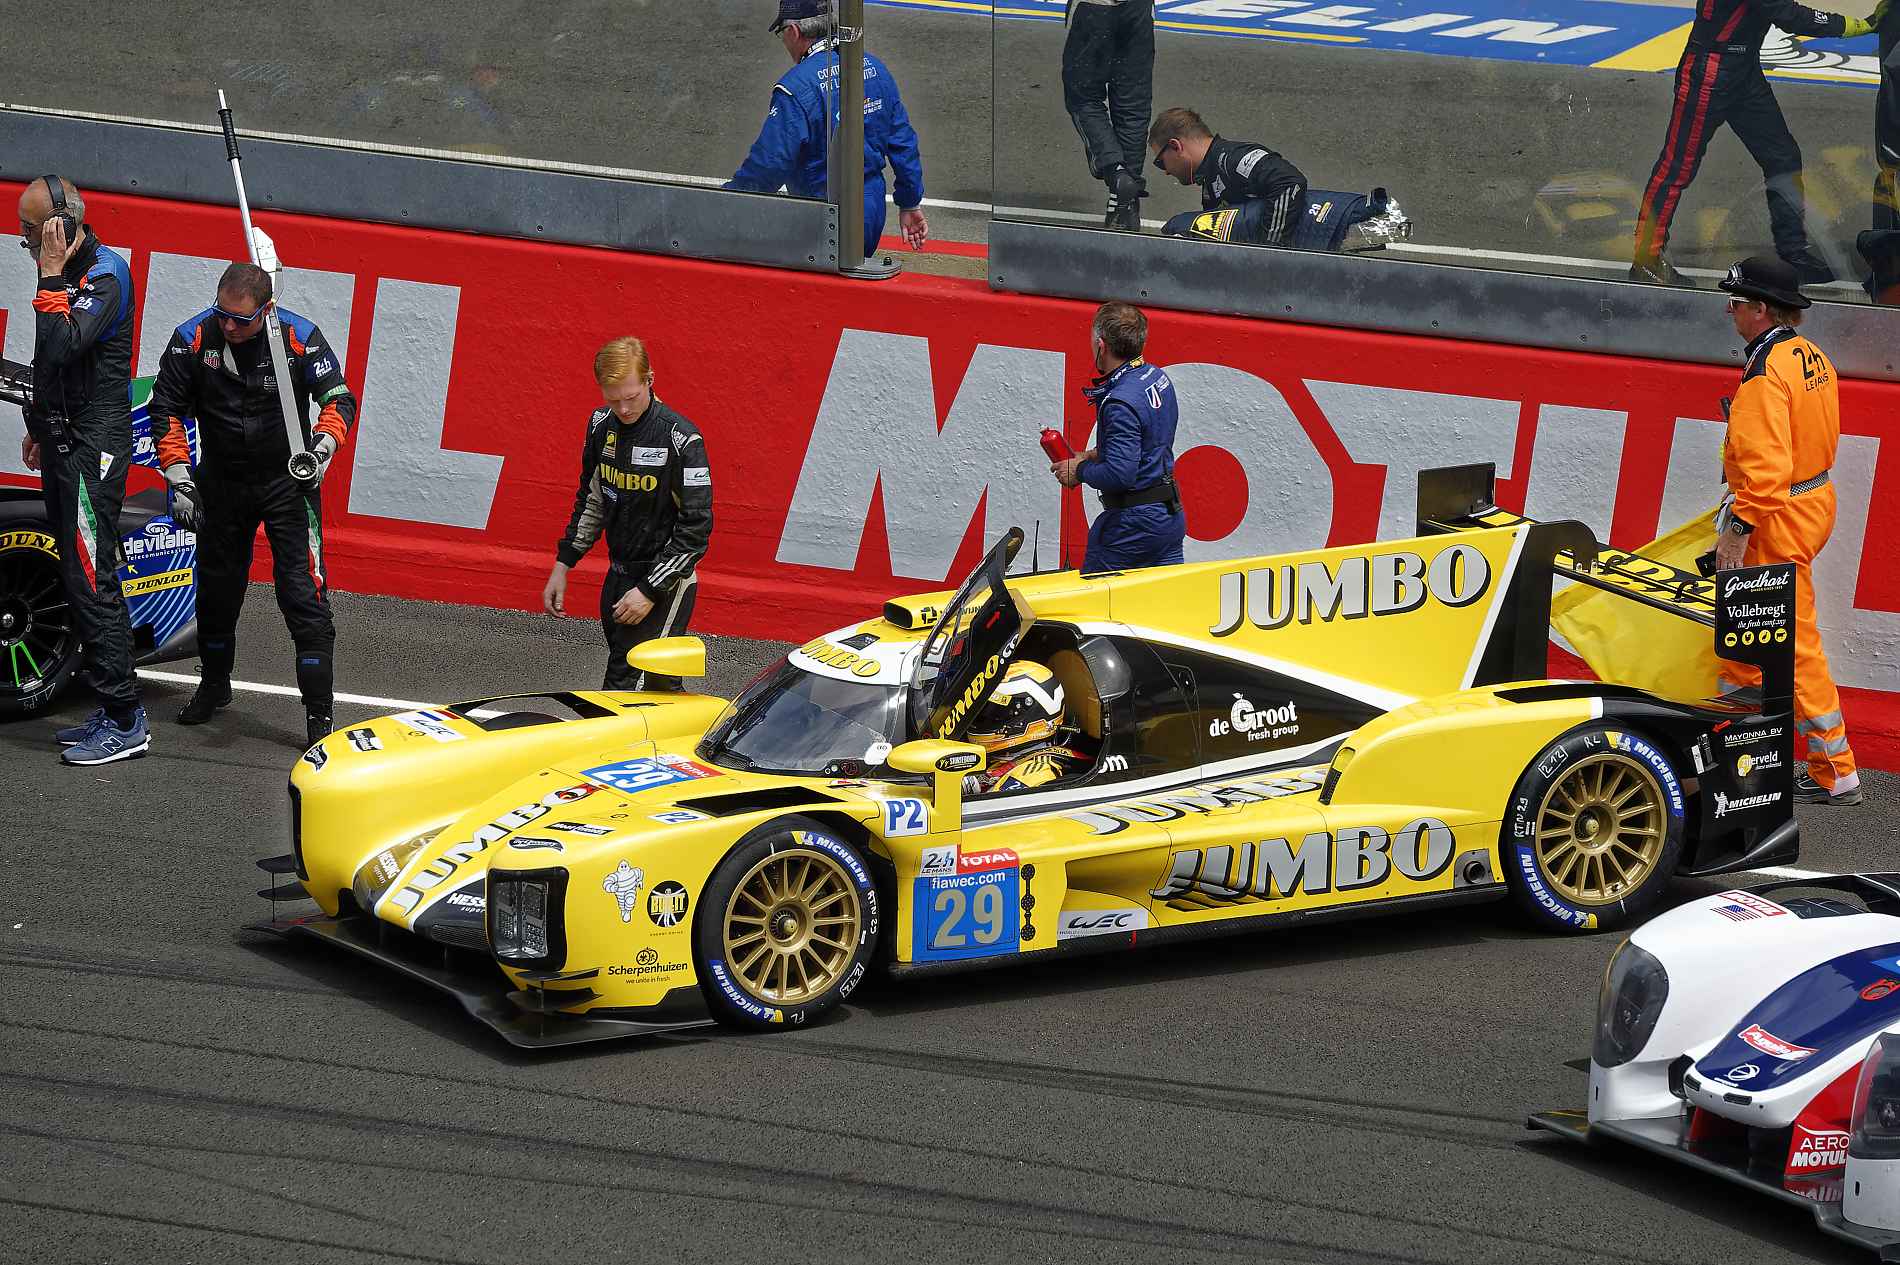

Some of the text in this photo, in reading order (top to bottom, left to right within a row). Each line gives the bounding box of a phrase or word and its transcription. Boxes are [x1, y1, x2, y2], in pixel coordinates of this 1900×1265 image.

[1308, 203, 1322, 216] 29
[313, 358, 332, 374] 24h
[1792, 344, 1826, 381] 24h
[598, 463, 658, 491] JUMBO
[123, 529, 196, 556] devitalia
[136, 573, 191, 591] DUNLOP
[1209, 543, 1492, 638] JUMBO
[1724, 570, 1790, 598] Goedhart
[1726, 603, 1786, 618] Vollebregt
[1745, 619, 1761, 630] fresh
[1247, 724, 1299, 743] fresh group
[1724, 727, 1783, 742] MAYONNA BV
[591, 763, 674, 790] 29
[677, 762, 711, 778] TOTAL
[1634, 741, 1682, 811] MICHELIN
[1729, 791, 1782, 809] MICHELIN
[656, 811, 700, 823] P2
[886, 799, 924, 831] P2
[815, 837, 869, 884] MICHELIN
[924, 850, 955, 869] 24h
[959, 852, 1017, 867] TOTAL
[1148, 817, 1457, 900] JUMBO
[933, 866, 953, 874] MANS
[931, 870, 1006, 890] fiawec.com
[1521, 854, 1573, 921] MICHELIN
[933, 883, 1004, 948] 29
[1068, 912, 1133, 929] WEC
[608, 961, 688, 977] Scherpenhuizen
[712, 964, 763, 1016] MICHELIN
[1800, 1136, 1850, 1151] AERO
[1791, 1151, 1847, 1168] MOTUL
